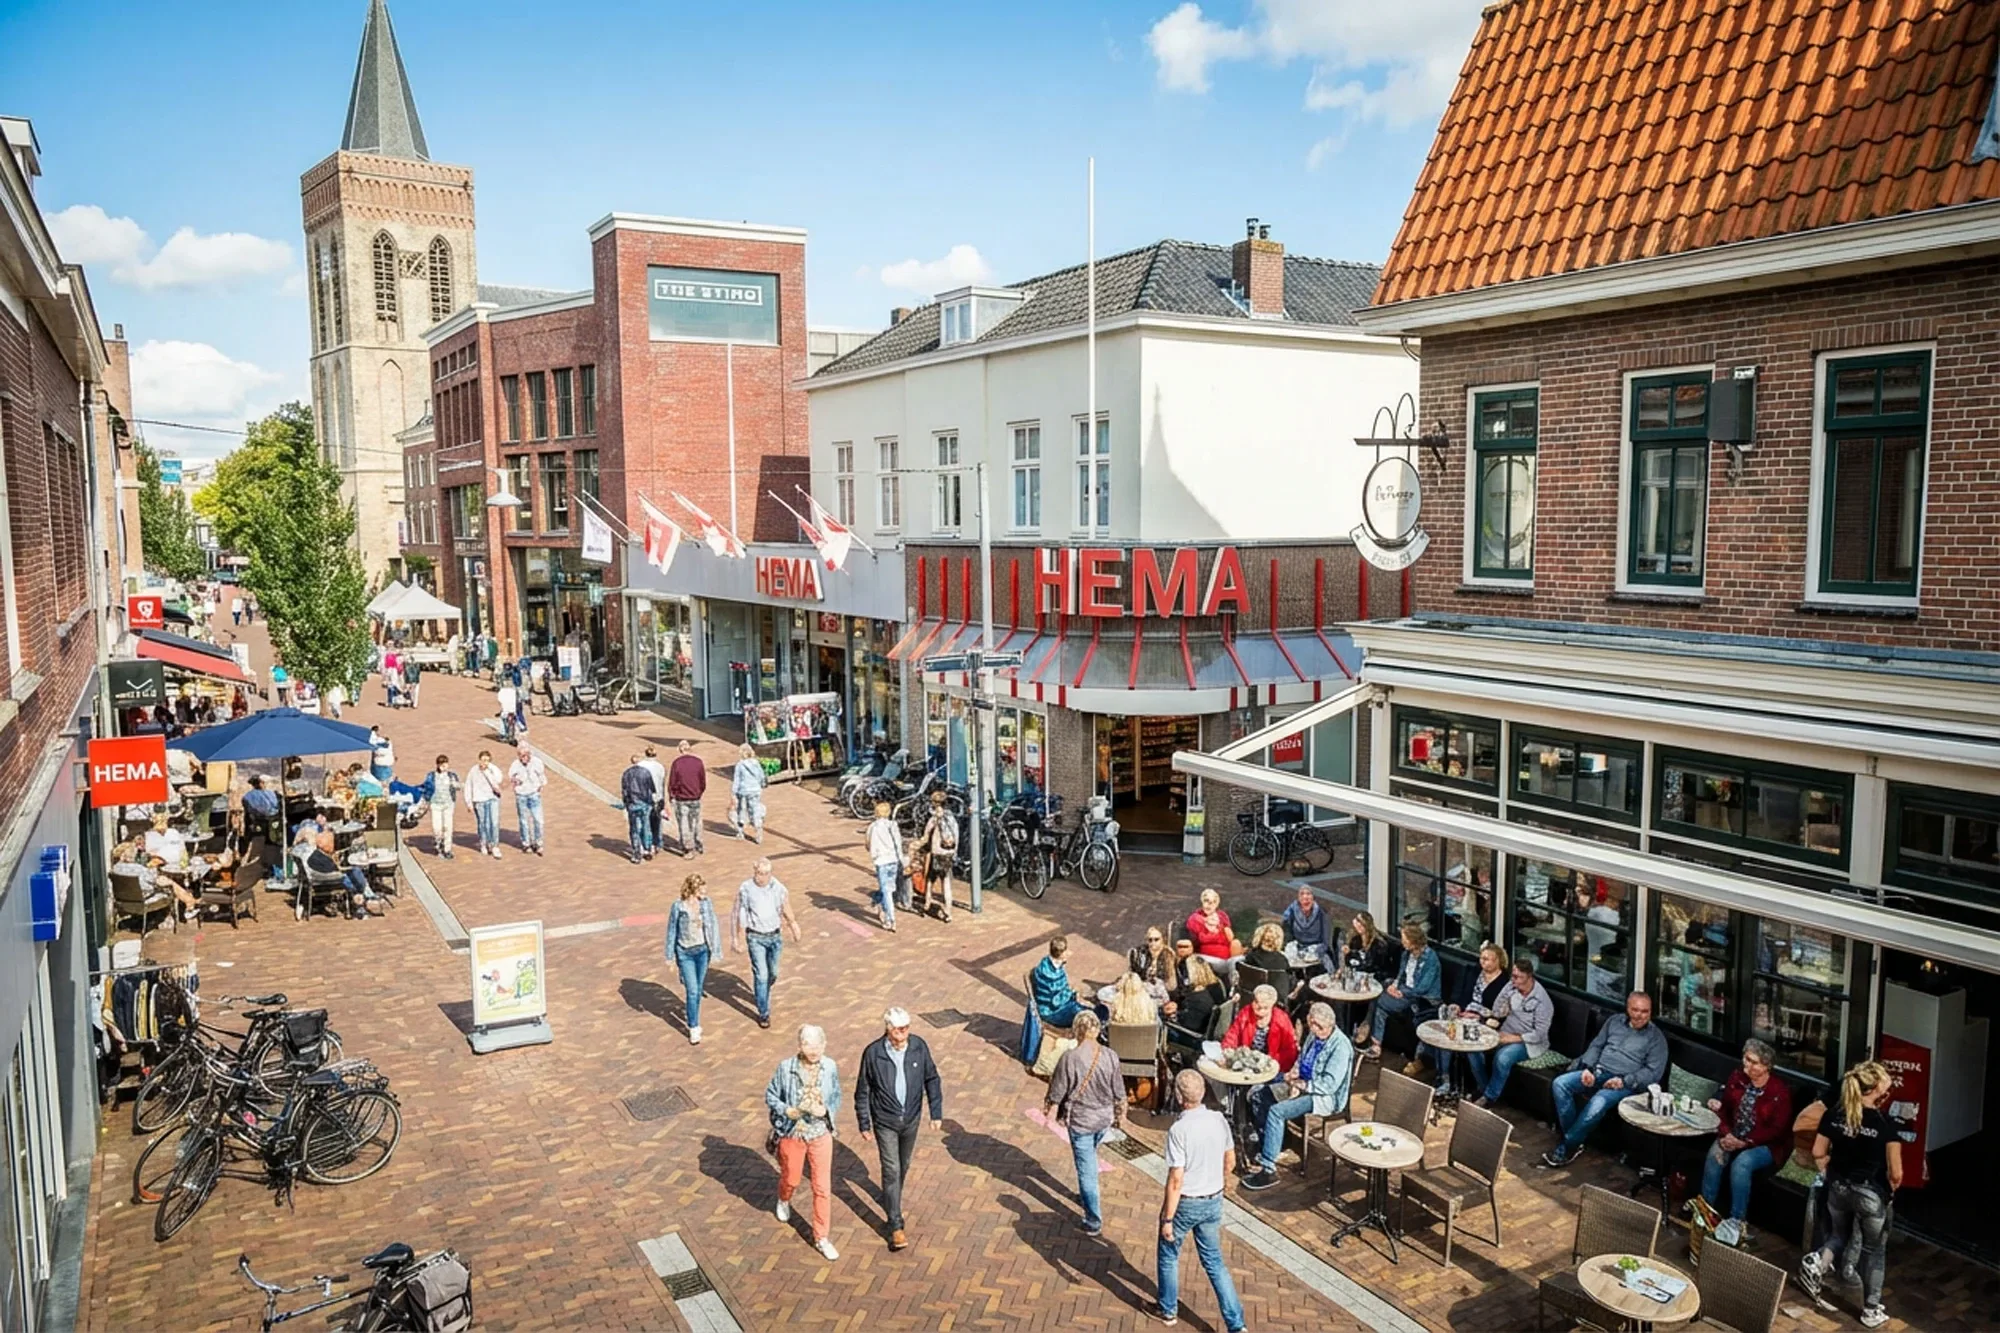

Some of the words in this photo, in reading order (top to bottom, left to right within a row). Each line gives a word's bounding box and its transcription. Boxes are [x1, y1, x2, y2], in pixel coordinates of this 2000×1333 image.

[756, 556, 824, 600] HEMA
[1034, 546, 1251, 619] HEMA
[94, 761, 163, 783] HEMA
